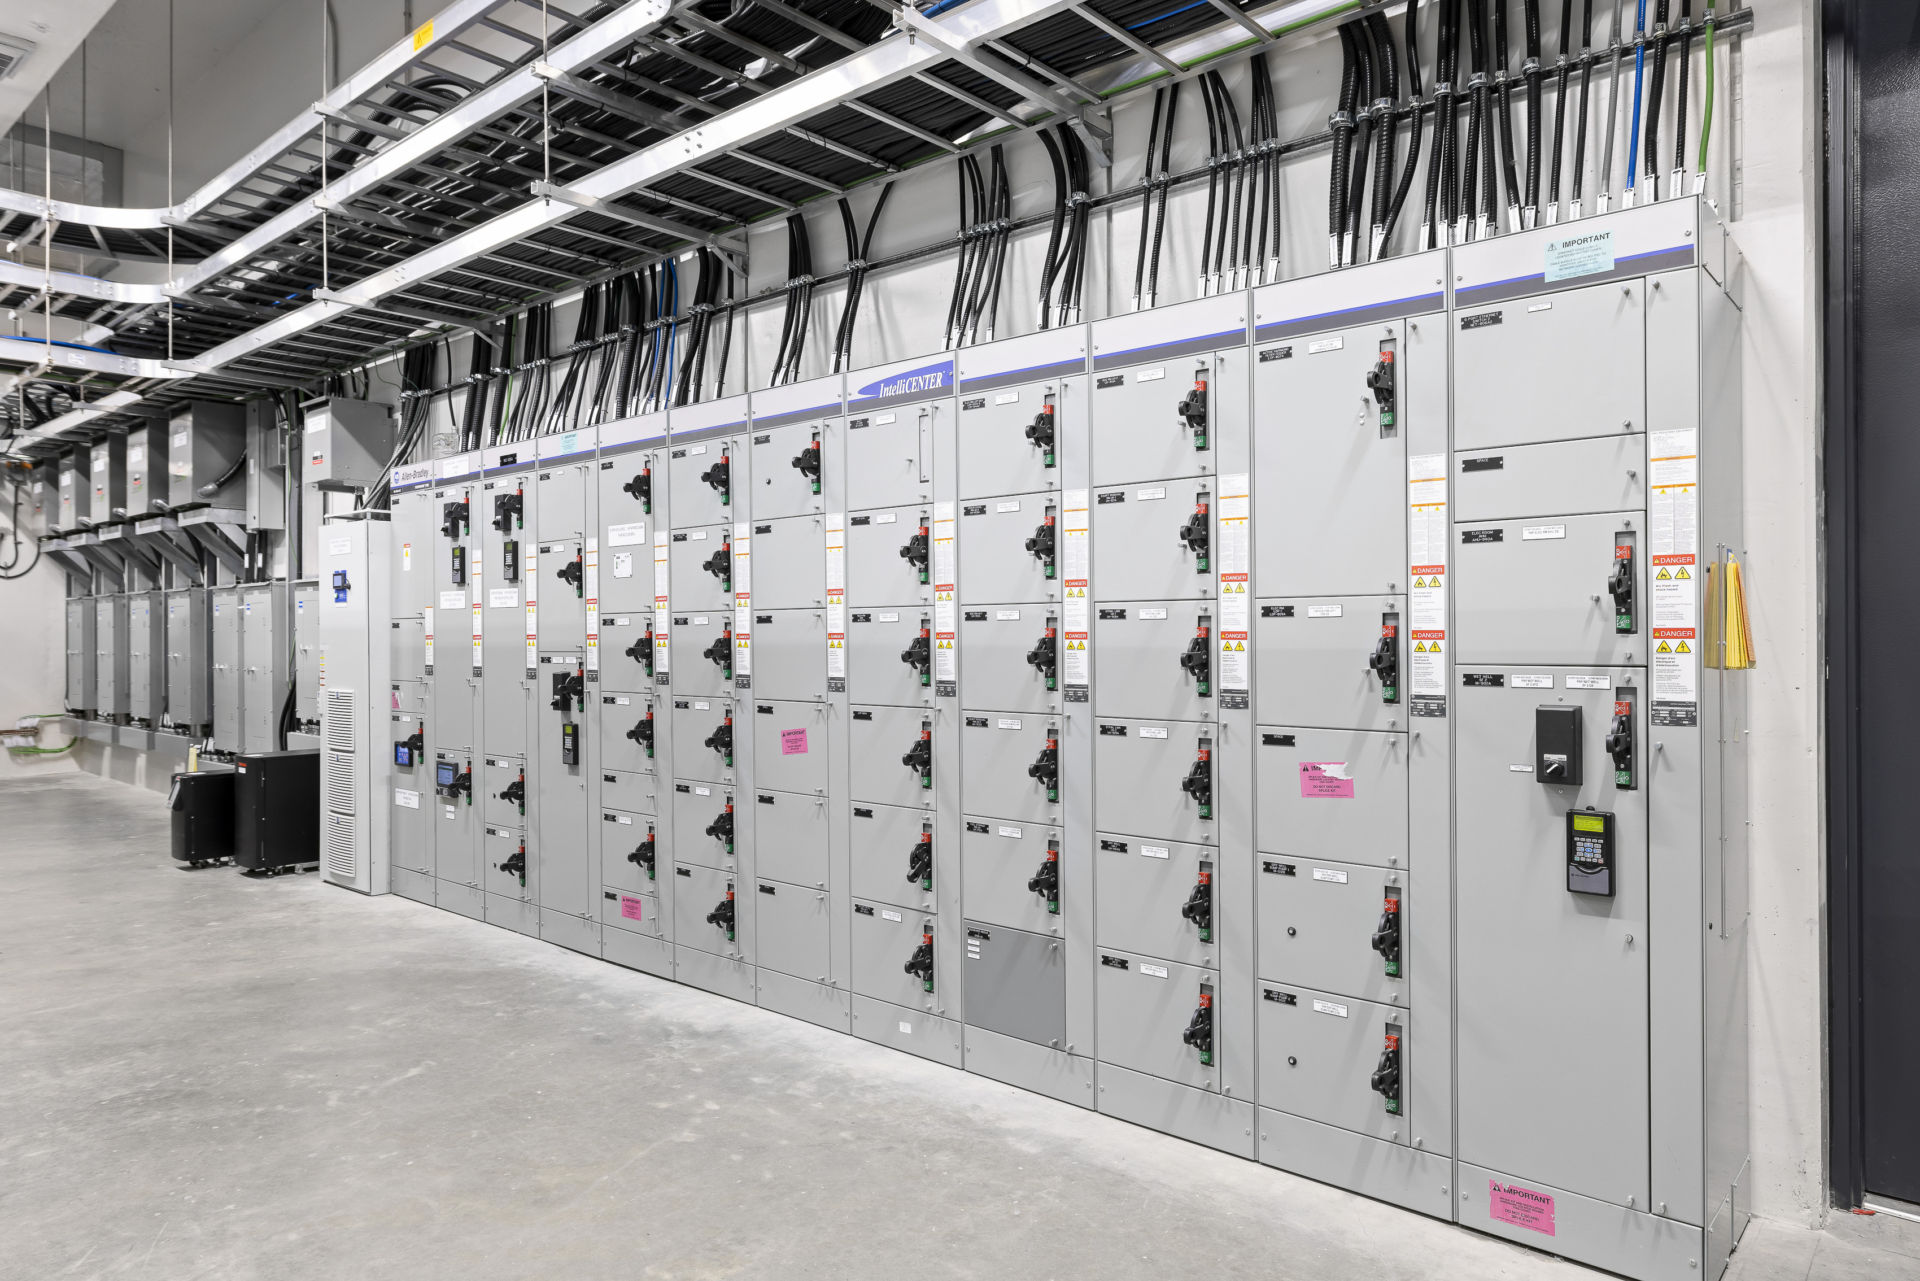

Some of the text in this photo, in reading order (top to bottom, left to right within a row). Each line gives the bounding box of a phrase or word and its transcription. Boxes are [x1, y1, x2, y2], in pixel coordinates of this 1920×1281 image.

[1562, 232, 1610, 249] IMPORTANT
[879, 372, 943, 398] IntelliCENTER
[401, 468, 429, 481] Allen-Bradley
[1503, 1188, 1551, 1205] IMPORTANT
